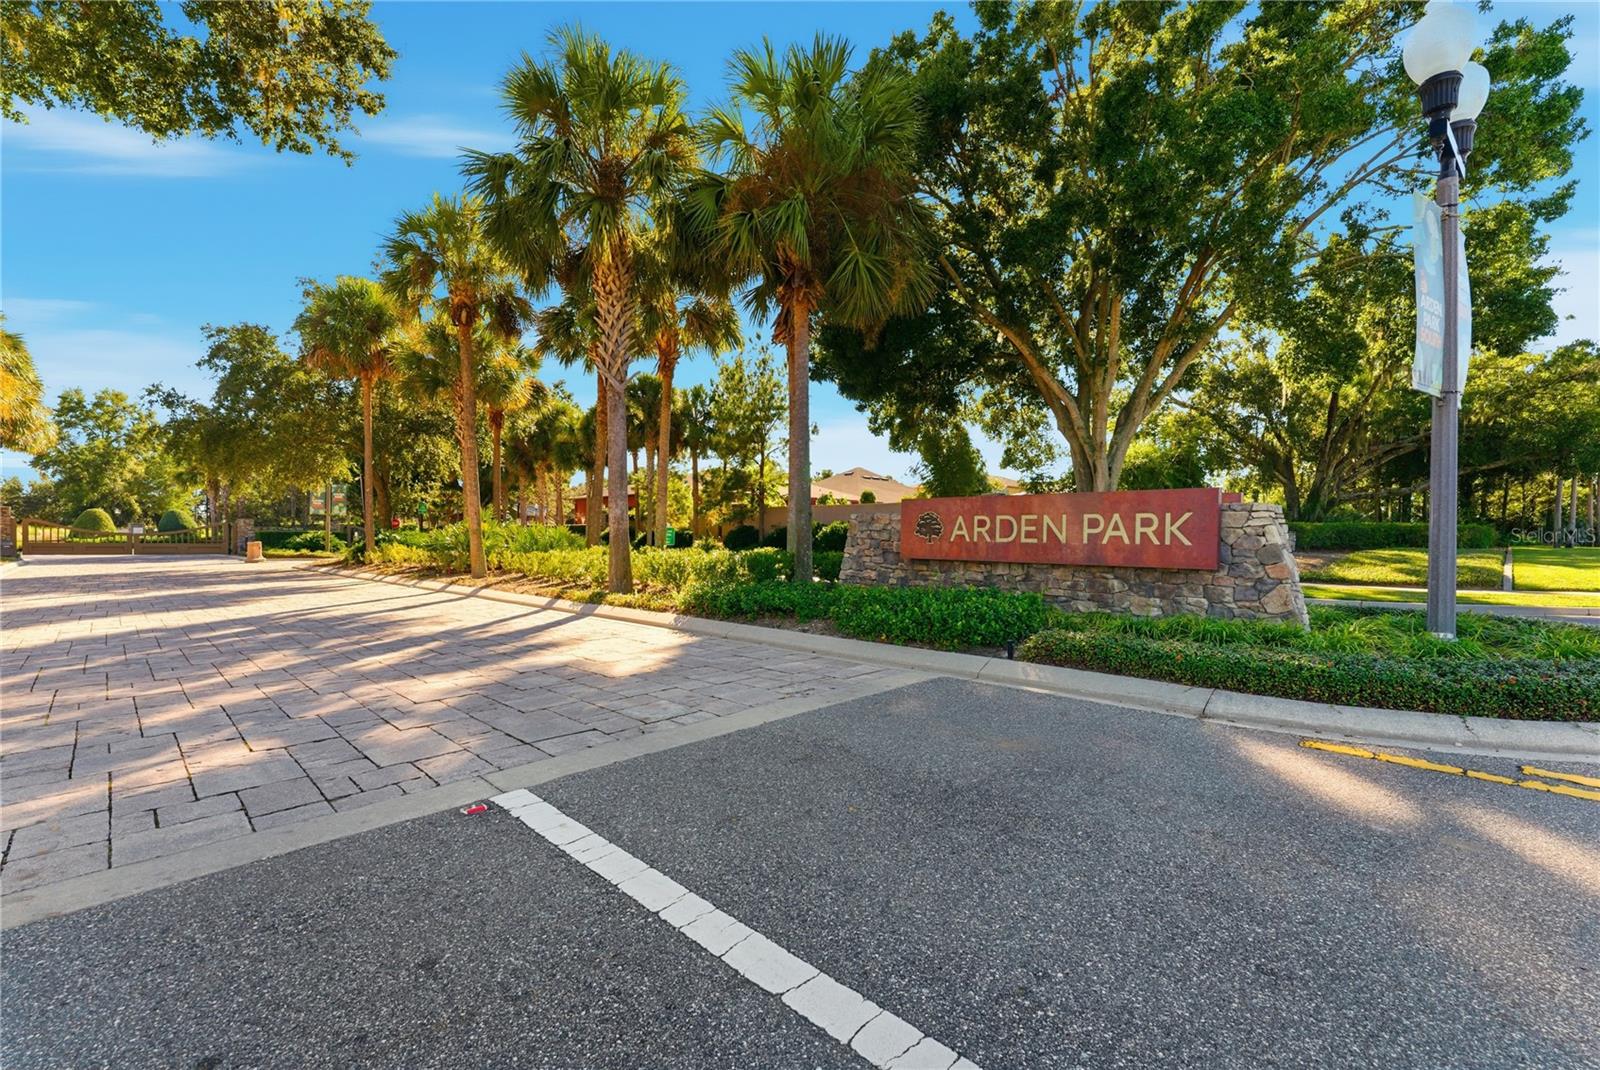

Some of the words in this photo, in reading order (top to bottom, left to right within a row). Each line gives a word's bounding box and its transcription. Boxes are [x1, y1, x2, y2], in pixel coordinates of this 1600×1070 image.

[1423, 312, 1441, 333] PARK
[950, 514, 1067, 544] ARDEN
[1083, 512, 1193, 546] PARK
